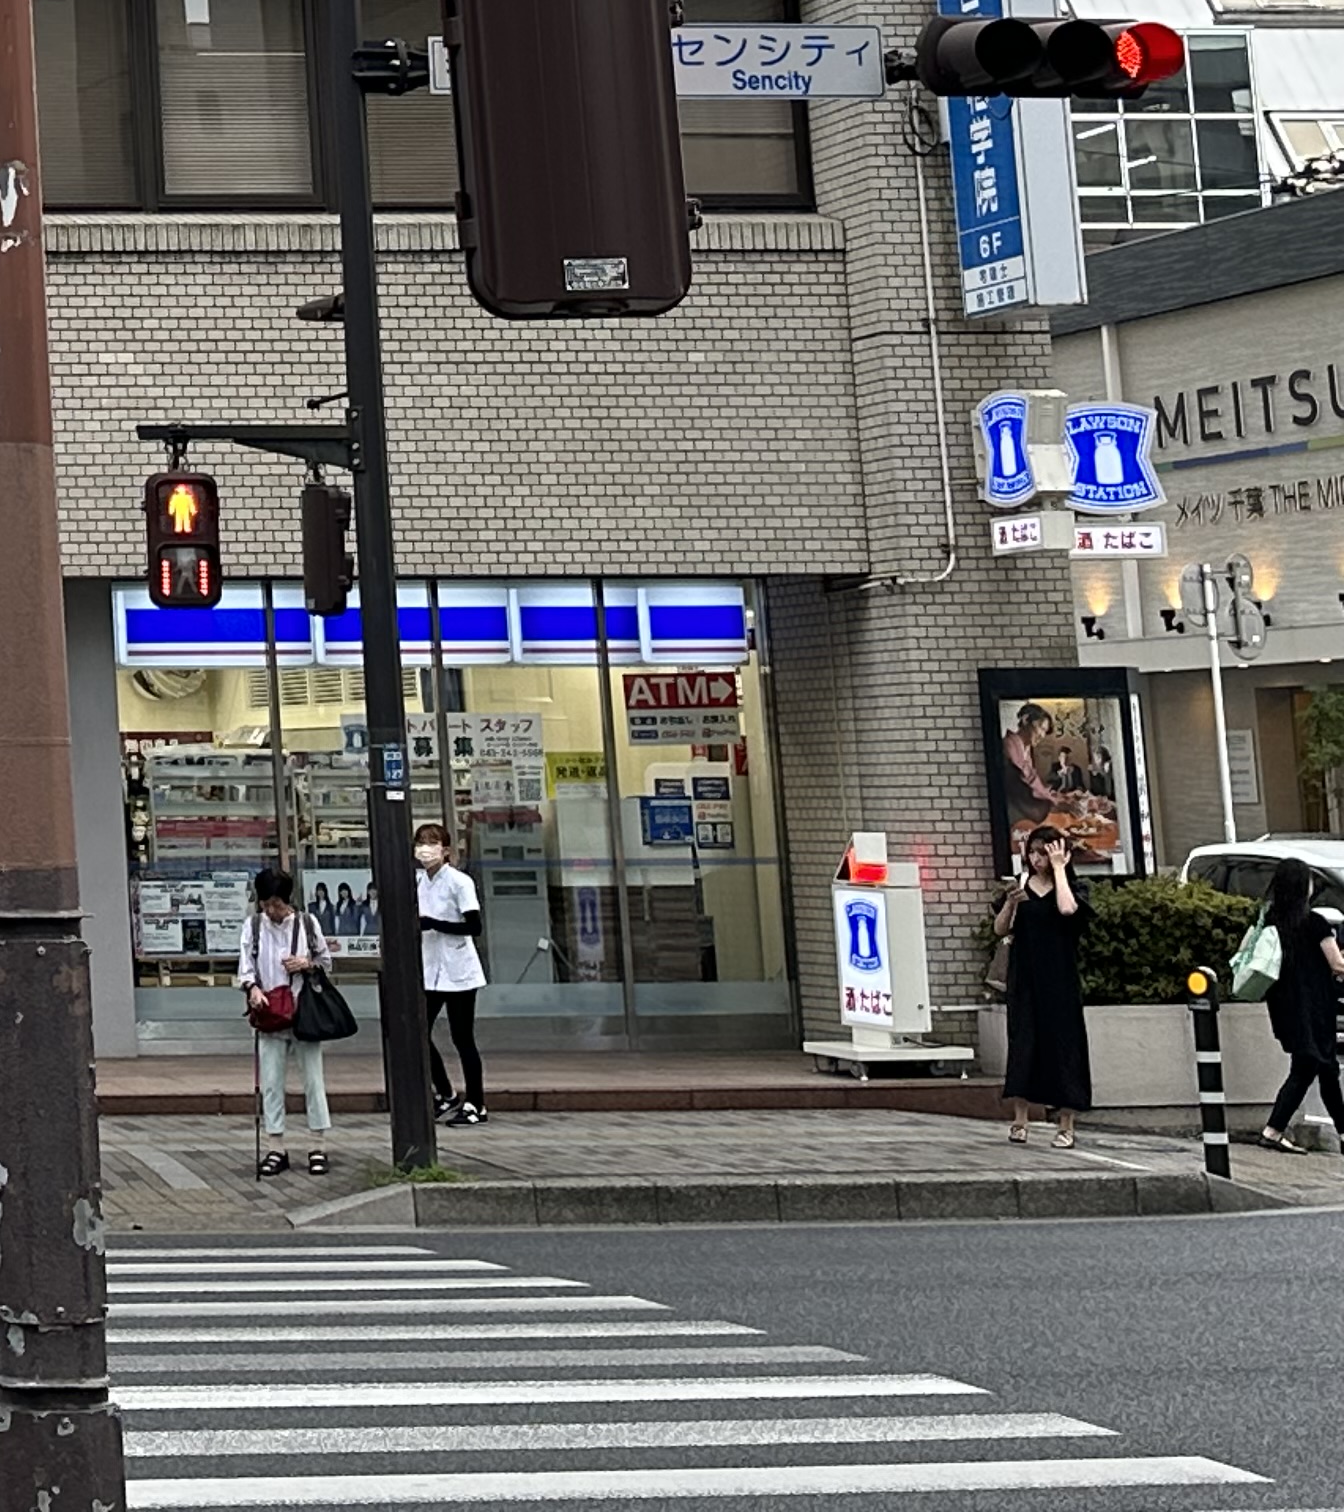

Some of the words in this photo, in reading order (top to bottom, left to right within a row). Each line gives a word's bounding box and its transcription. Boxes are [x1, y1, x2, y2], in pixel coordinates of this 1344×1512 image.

[672, 34, 870, 67] センシティ
[732, 69, 812, 95] Sencity
[979, 232, 1002, 258] 6F
[1066, 415, 1141, 435] LAWSON
[1075, 481, 1148, 499] STATION
[1268, 481, 1312, 515] THE
[1103, 531, 1154, 550] たばこ
[628, 676, 709, 706] ATM
[480, 718, 533, 734] スタッフ
